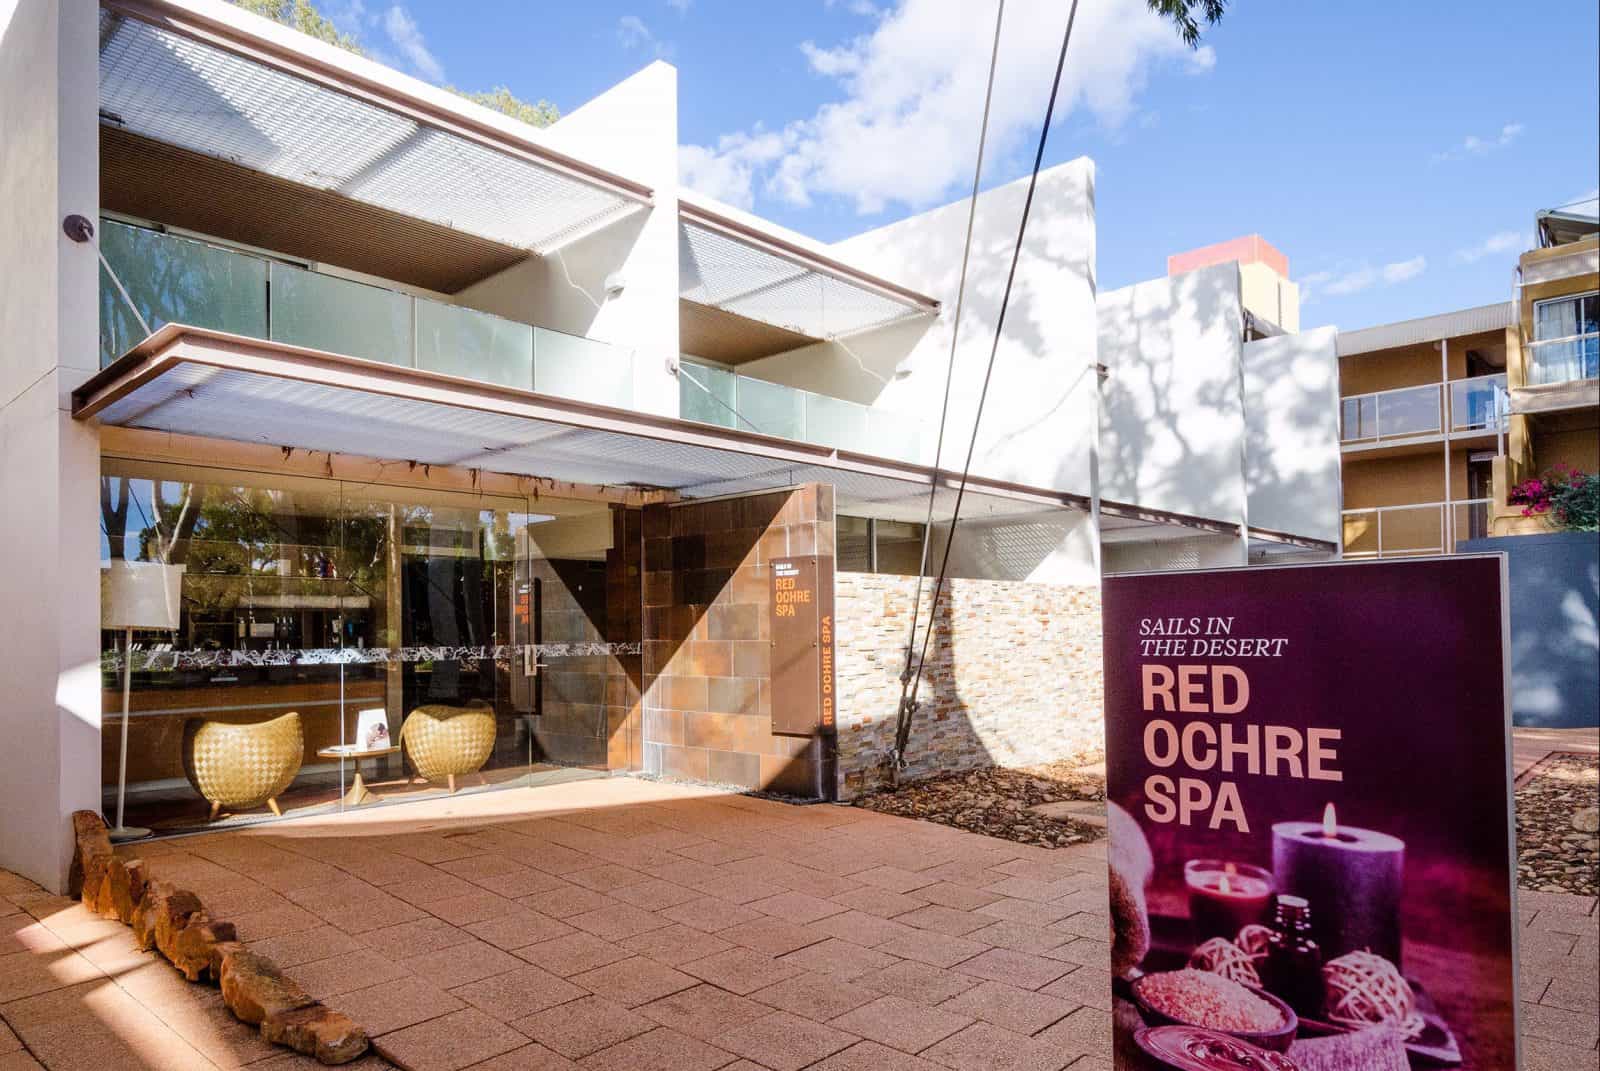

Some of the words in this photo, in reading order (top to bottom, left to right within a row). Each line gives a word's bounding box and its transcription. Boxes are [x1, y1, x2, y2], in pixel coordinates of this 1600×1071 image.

[776, 578, 795, 590] RED
[776, 590, 810, 603] OCHRE
[776, 604, 795, 616] SPA
[822, 616, 832, 643] SPA
[1139, 618, 1201, 636] SAILS
[1205, 617, 1235, 635] IN
[1139, 640, 1187, 657] THE
[1190, 639, 1288, 657] DESERT
[823, 647, 832, 693] OCHRE
[1142, 664, 1250, 714] RED
[823, 697, 833, 725] RED
[1143, 719, 1344, 782] OCHRE
[1144, 775, 1250, 833] SPA
